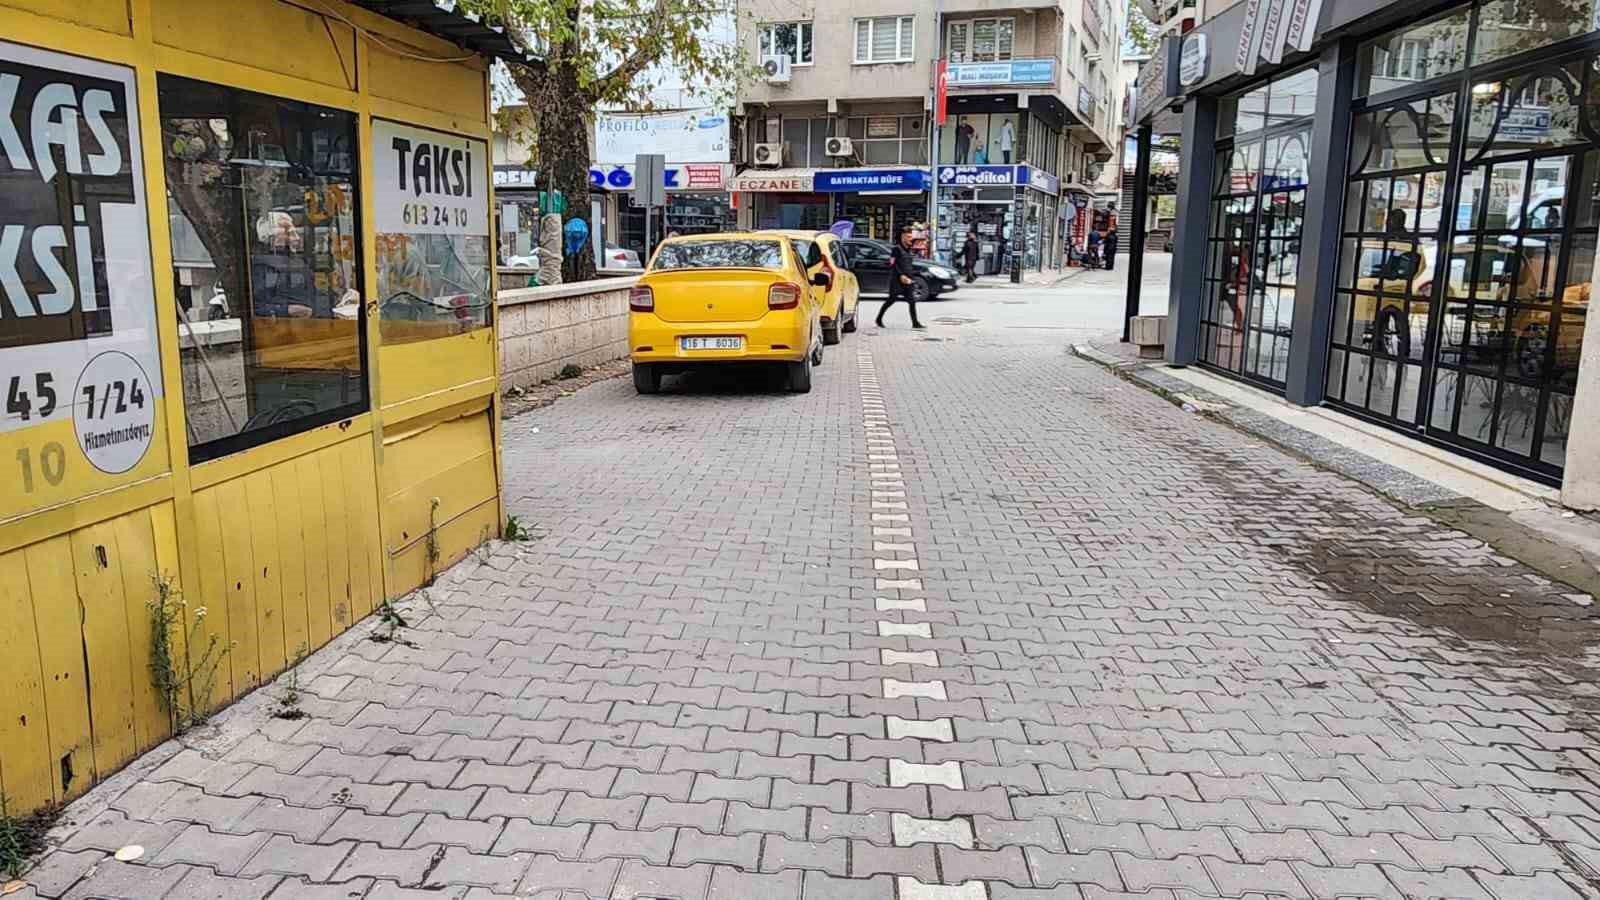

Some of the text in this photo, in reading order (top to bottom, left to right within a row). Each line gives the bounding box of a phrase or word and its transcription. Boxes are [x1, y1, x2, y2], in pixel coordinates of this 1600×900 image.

[392, 136, 473, 198] TAKSİ
[830, 174, 904, 185] BAYRAKTAR BÜFE
[956, 171, 1011, 184] medikal
[739, 180, 800, 190] ECZANE
[402, 203, 468, 228] 613 24 10
[687, 338, 698, 348] 16
[6, 371, 57, 421] 45
[82, 377, 145, 420] 7/24
[16, 441, 66, 494] 10
